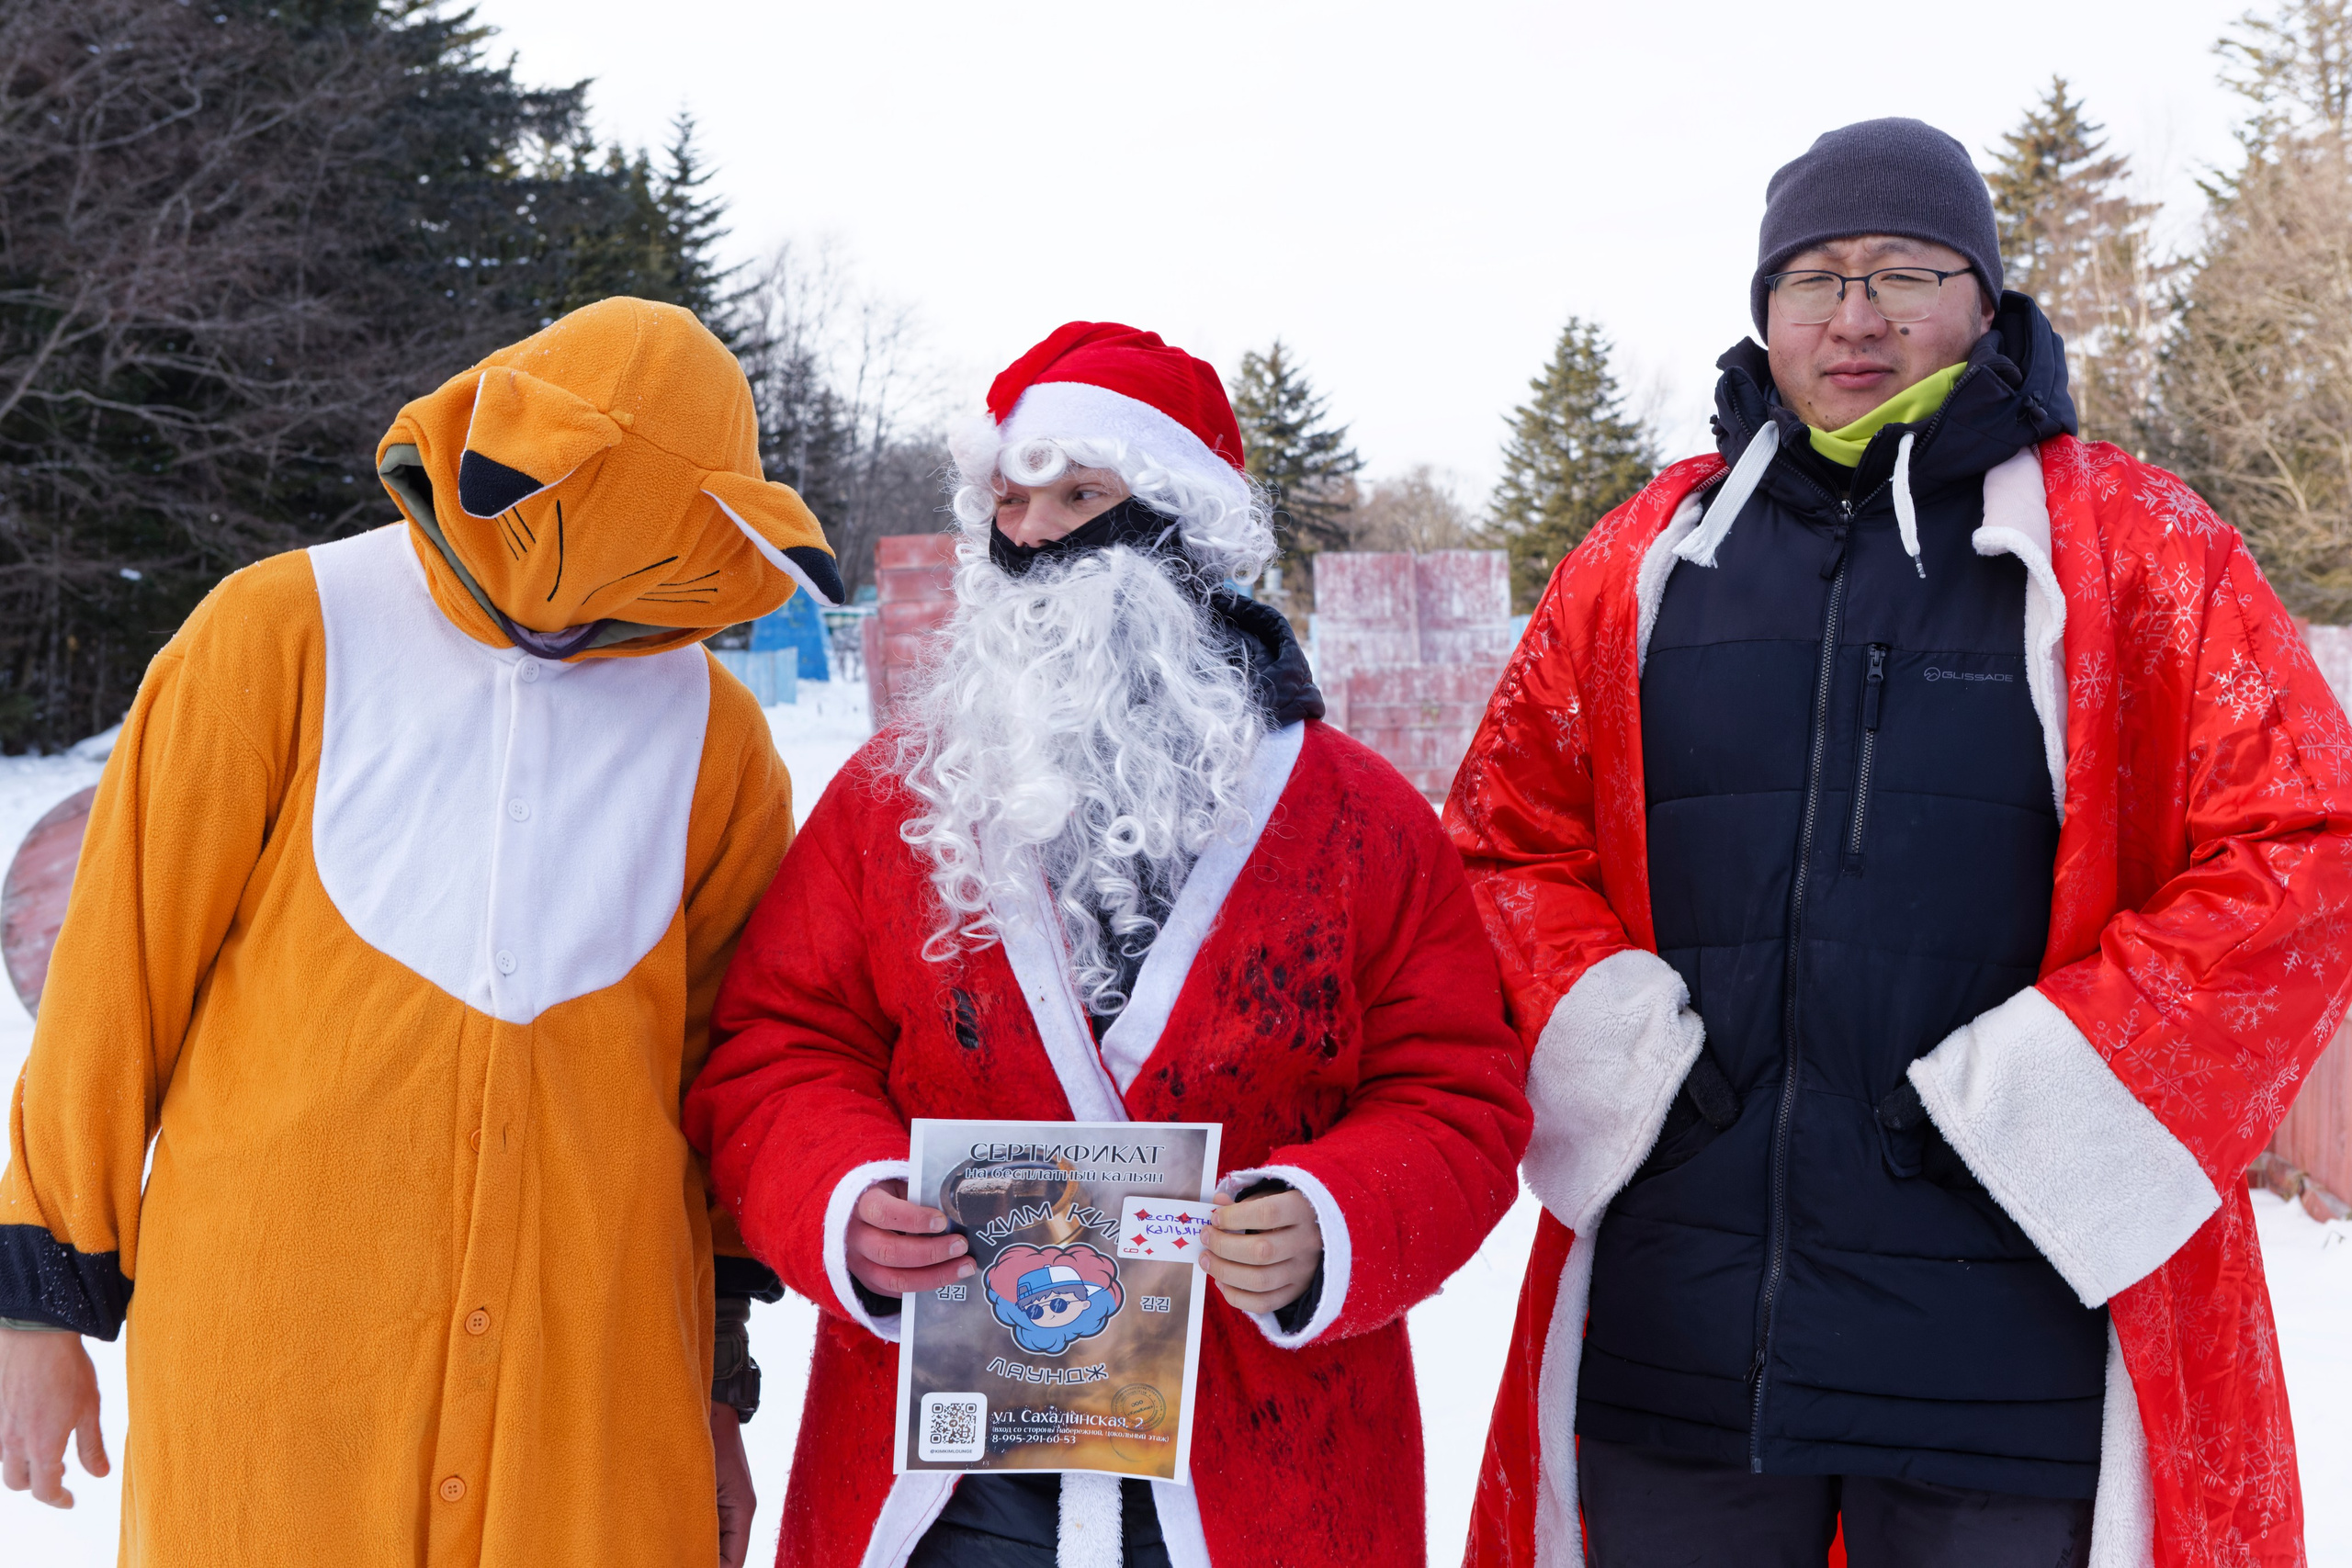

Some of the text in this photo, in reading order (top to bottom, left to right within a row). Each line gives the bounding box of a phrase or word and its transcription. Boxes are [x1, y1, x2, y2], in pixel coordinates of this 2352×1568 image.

[1941, 671, 2014, 682] GLISSADE
[969, 1143, 1165, 1165] СЕРТИФИКАТ
[966, 1167, 1164, 1183] на бесплатный кальян
[976, 1201, 1054, 1246] КИМ
[936, 1285, 967, 1300] 김김
[1141, 1295, 1170, 1312] 김김
[987, 1357, 1108, 1385] ЛАУНДЖ
[992, 1411, 1016, 1424] ул.
[1135, 1416, 1144, 1429] 2
[991, 1434, 1077, 1444] 8-995-291-60-53
